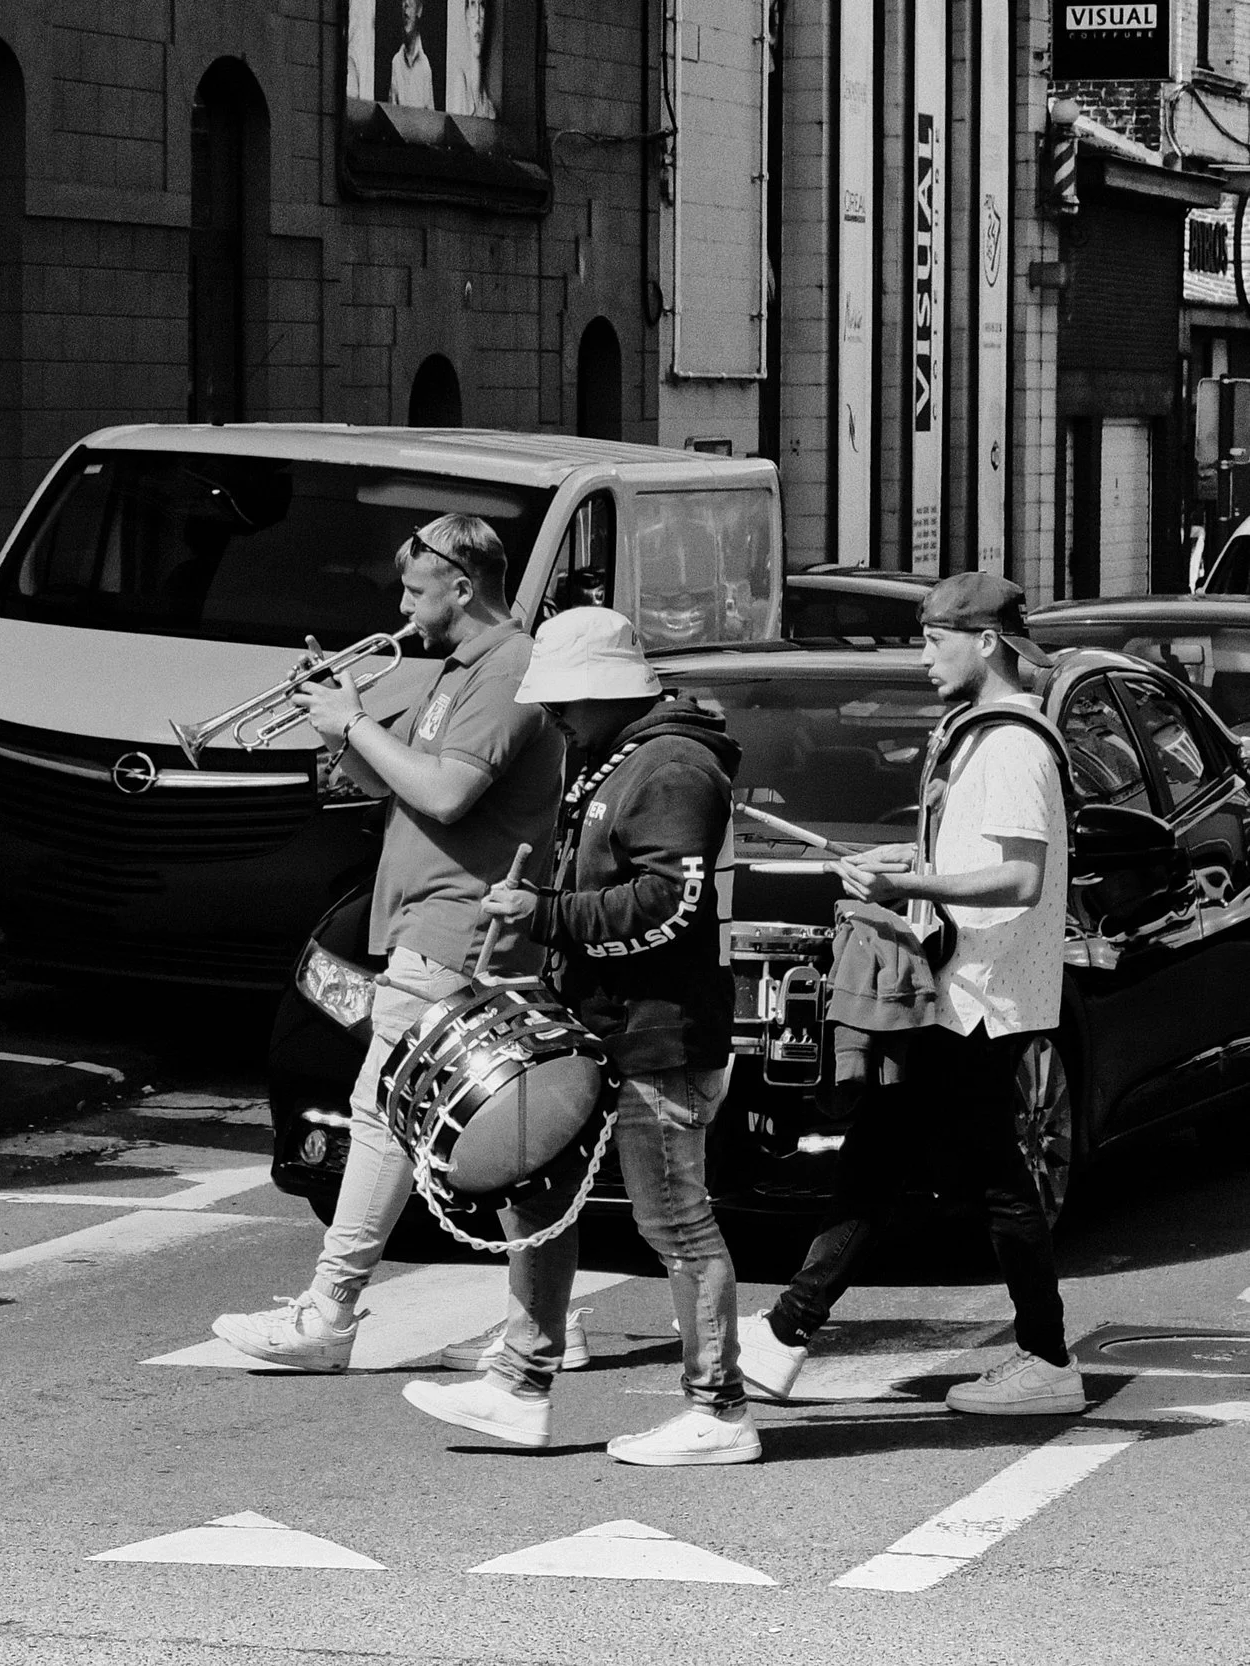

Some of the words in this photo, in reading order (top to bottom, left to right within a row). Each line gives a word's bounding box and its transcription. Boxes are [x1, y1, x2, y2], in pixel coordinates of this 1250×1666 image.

[1070, 7, 1154, 26] VISUAL
[916, 127, 934, 418] VISUAL
[584, 856, 705, 958] HOLLISTER
